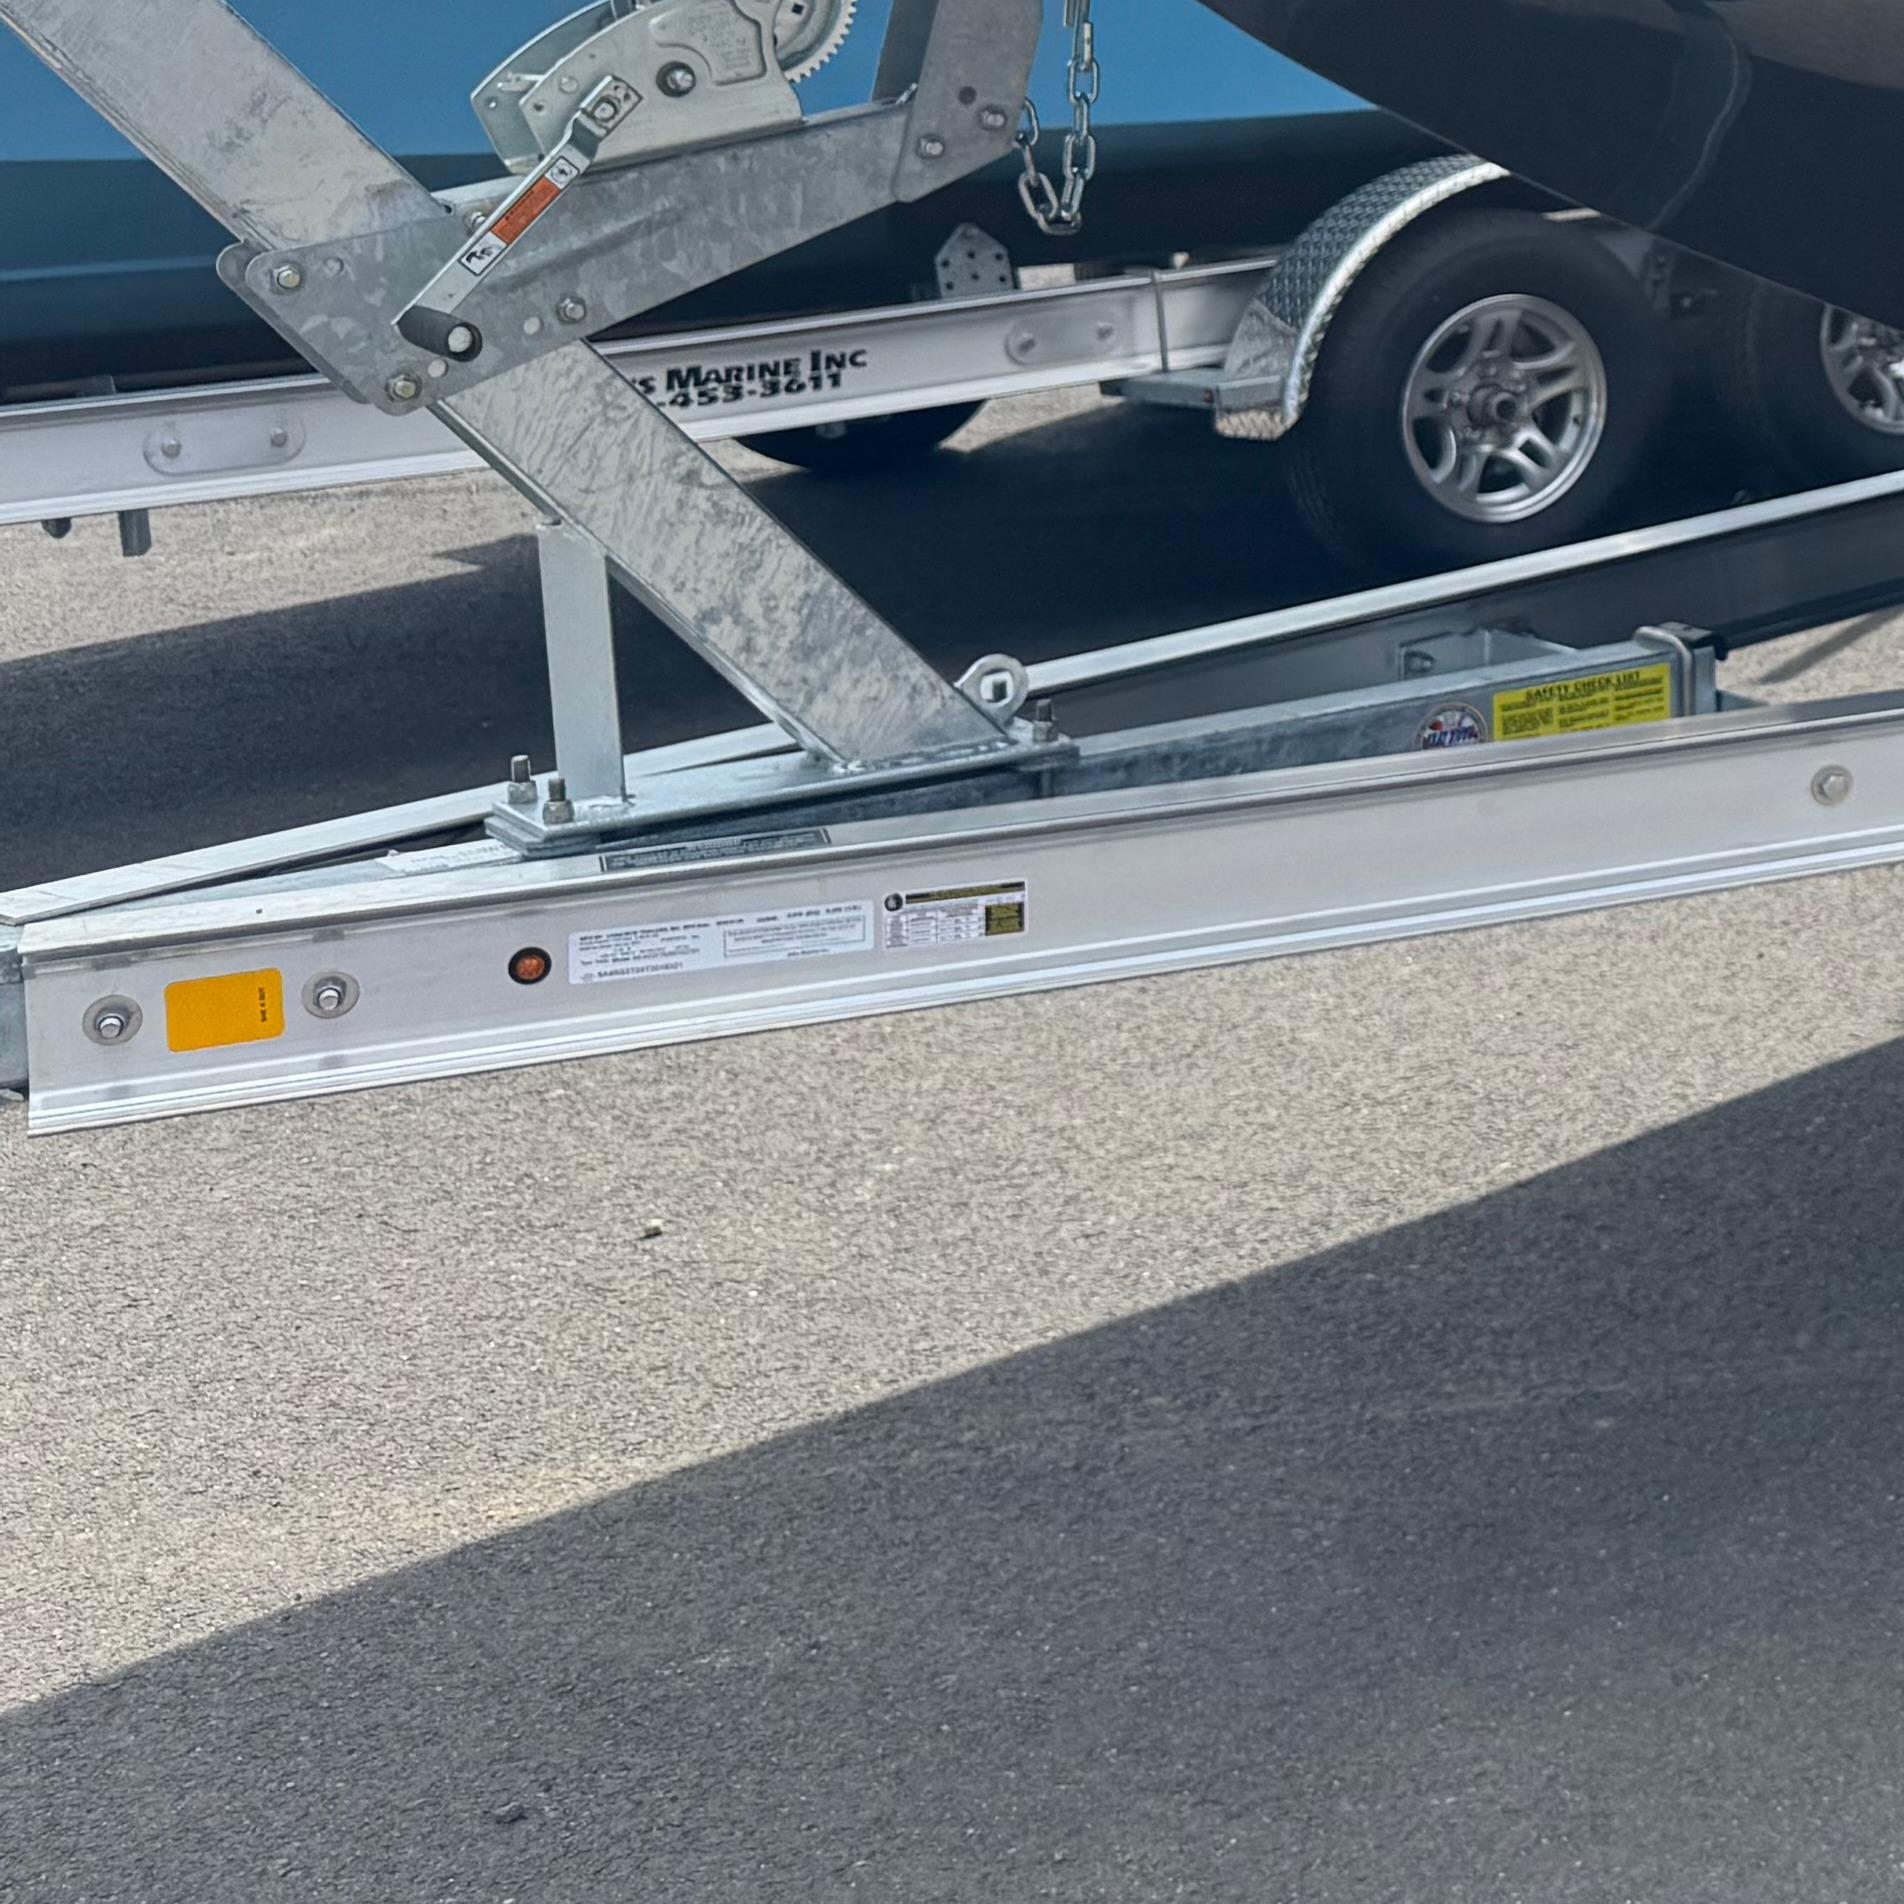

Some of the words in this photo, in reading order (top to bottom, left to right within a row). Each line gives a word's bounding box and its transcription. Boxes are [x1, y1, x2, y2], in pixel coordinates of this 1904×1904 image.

[657, 373, 842, 408] -453-3611
[665, 358, 801, 393] MARINE
[810, 349, 868, 372] INC
